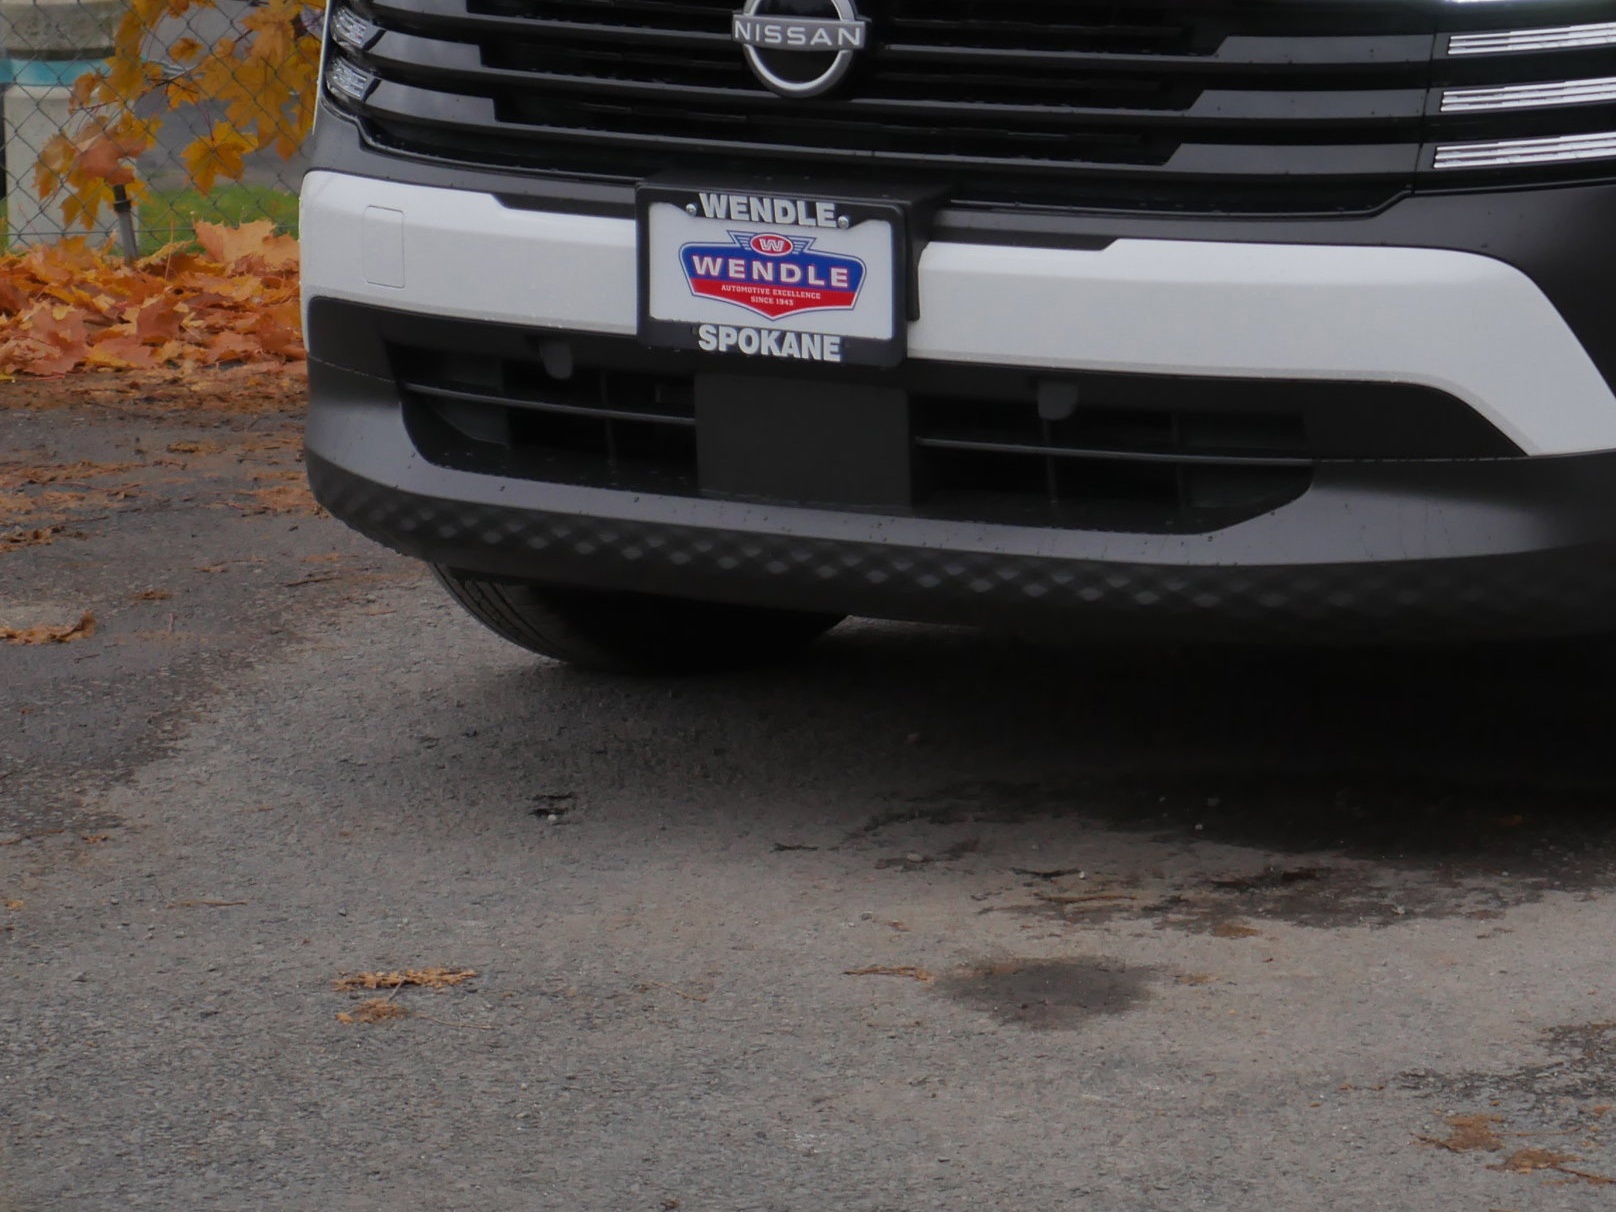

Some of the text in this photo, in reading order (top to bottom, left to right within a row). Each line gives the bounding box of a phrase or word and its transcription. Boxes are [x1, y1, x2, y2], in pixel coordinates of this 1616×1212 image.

[734, 19, 860, 46] NISSAN
[699, 192, 837, 228] WENDLE
[692, 255, 849, 288] WENDLE
[721, 284, 821, 300] AUTOMOTIVE EXCELLENCE
[750, 295, 794, 306] SINCE 1943
[698, 323, 841, 363] SPOKANE
